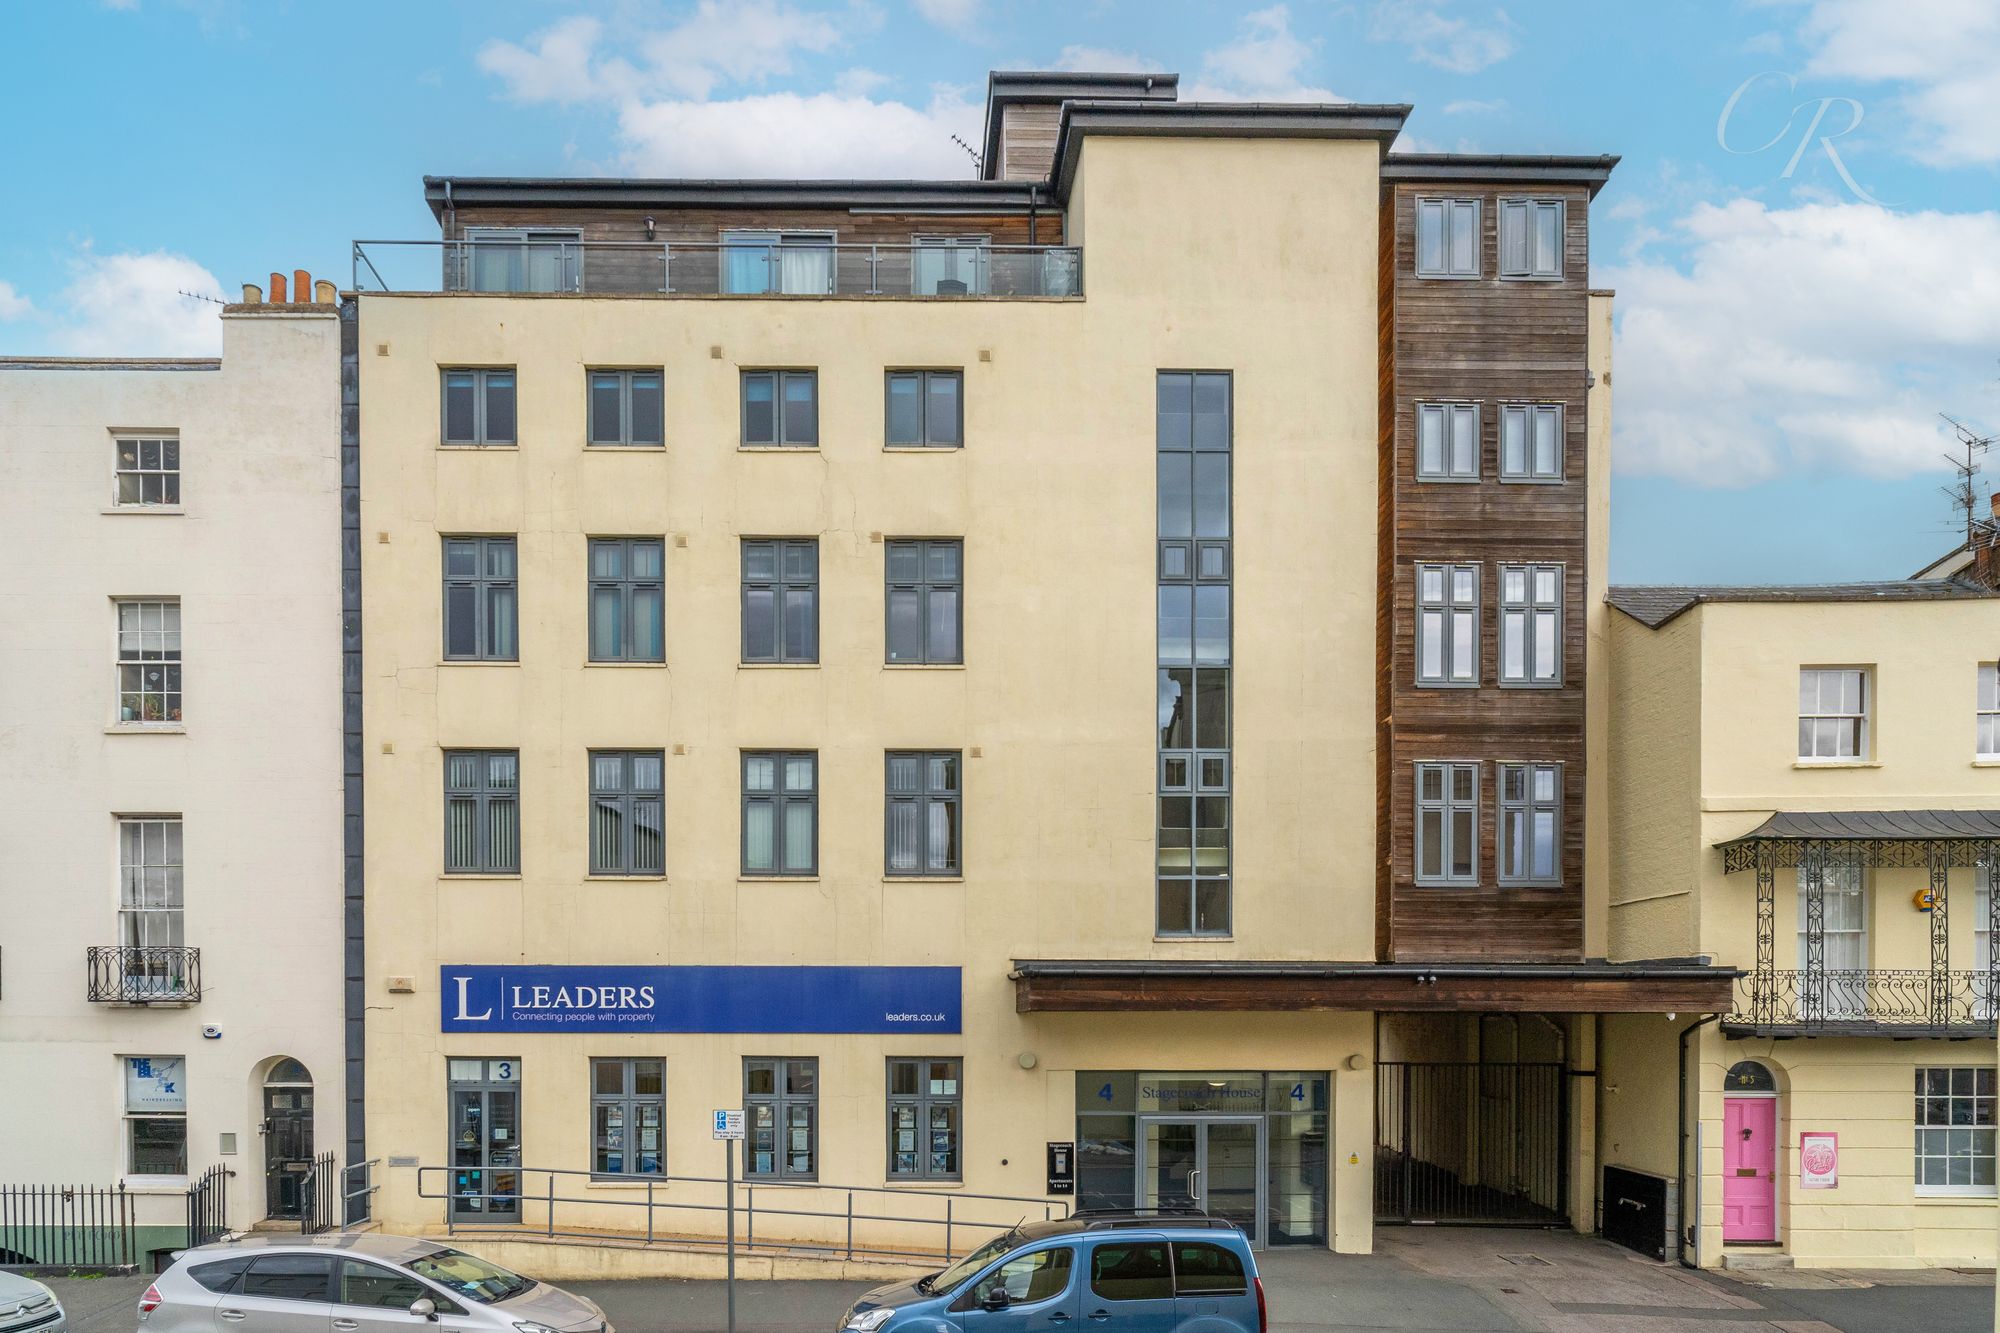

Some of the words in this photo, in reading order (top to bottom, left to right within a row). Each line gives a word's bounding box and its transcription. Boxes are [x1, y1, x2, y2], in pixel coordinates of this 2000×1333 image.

[452, 976, 493, 1021] L
[511, 986, 655, 1009] LEADERS
[512, 1011, 563, 1023] Connecting
[565, 1012, 595, 1023] people
[597, 1011, 616, 1022] with
[617, 1012, 655, 1023] property
[885, 1012, 946, 1022] leaders.co.uk
[498, 1062, 512, 1080] 3
[1097, 1082, 1114, 1102] 4
[1142, 1085, 1217, 1101] Stagecoach
[1219, 1085, 1261, 1099] House
[1290, 1083, 1305, 1101] 4
